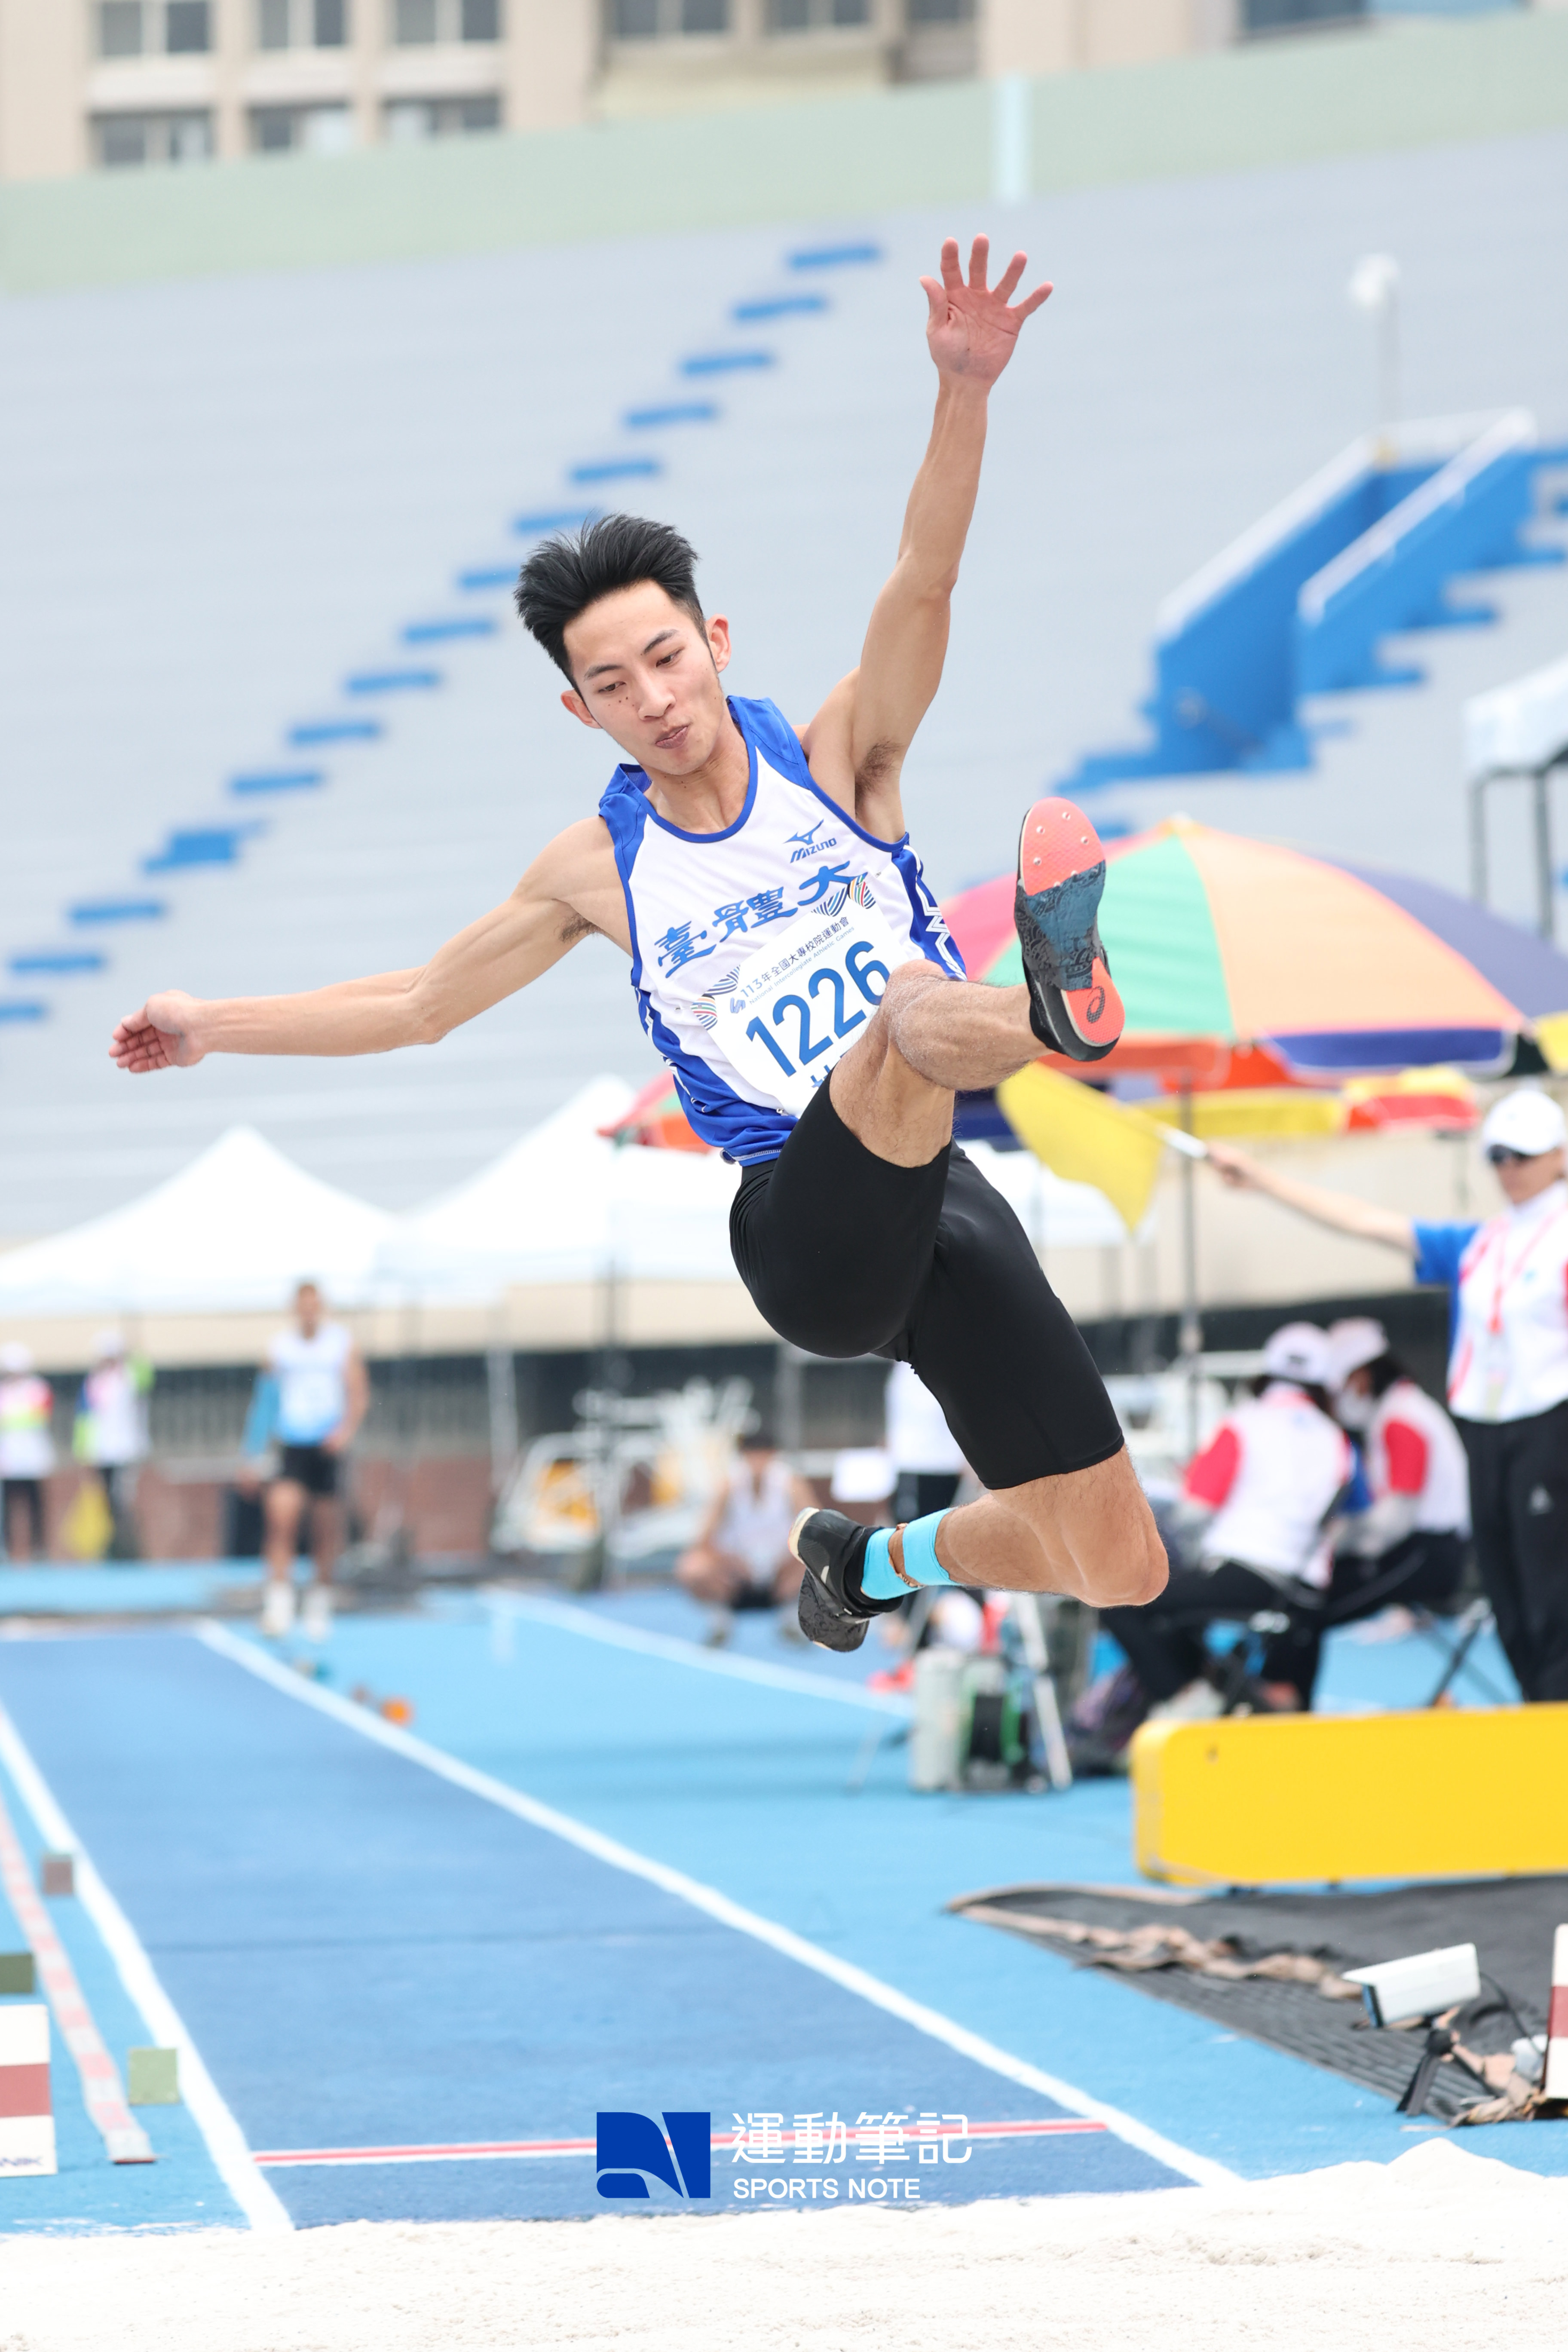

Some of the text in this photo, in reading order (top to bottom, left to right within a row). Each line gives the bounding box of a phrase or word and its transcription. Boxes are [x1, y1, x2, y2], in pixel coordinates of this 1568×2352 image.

[654, 860, 869, 978] 臺體大
[740, 916, 849, 998] 113年全國大專校院運動會
[749, 926, 855, 1005] National Intercollegiate Athletic Games
[746, 941, 891, 1078] 1226
